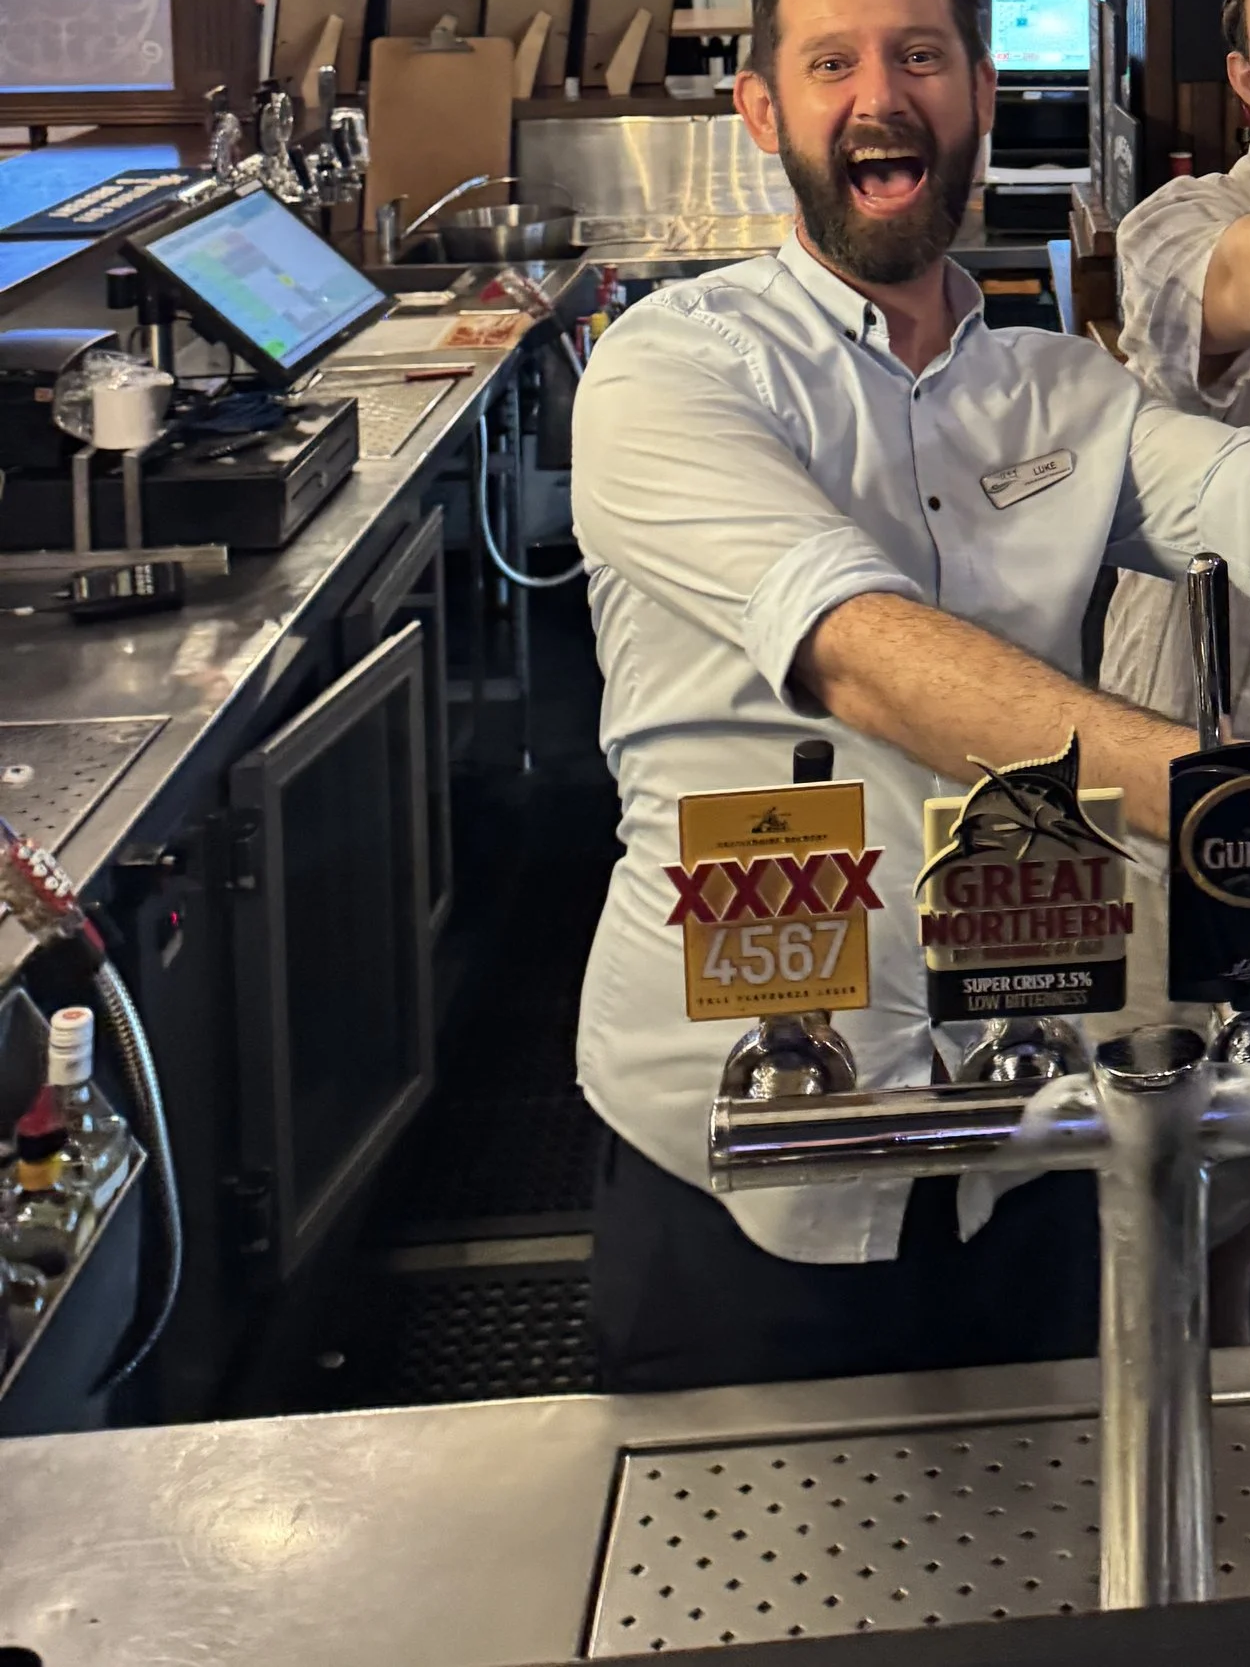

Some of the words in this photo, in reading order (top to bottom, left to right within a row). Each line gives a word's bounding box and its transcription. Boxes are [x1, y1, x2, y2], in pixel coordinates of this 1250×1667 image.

[1033, 461, 1057, 476] LUKE
[660, 847, 885, 926] XXXX
[944, 857, 1110, 908] GREAT
[920, 902, 1134, 946] NORTHERN
[702, 919, 849, 986] 4567
[962, 977, 1010, 993] SUPER
[1012, 975, 1055, 991] CRISP
[1056, 972, 1093, 987] 3.5%
[968, 994, 1001, 1011] LOW
